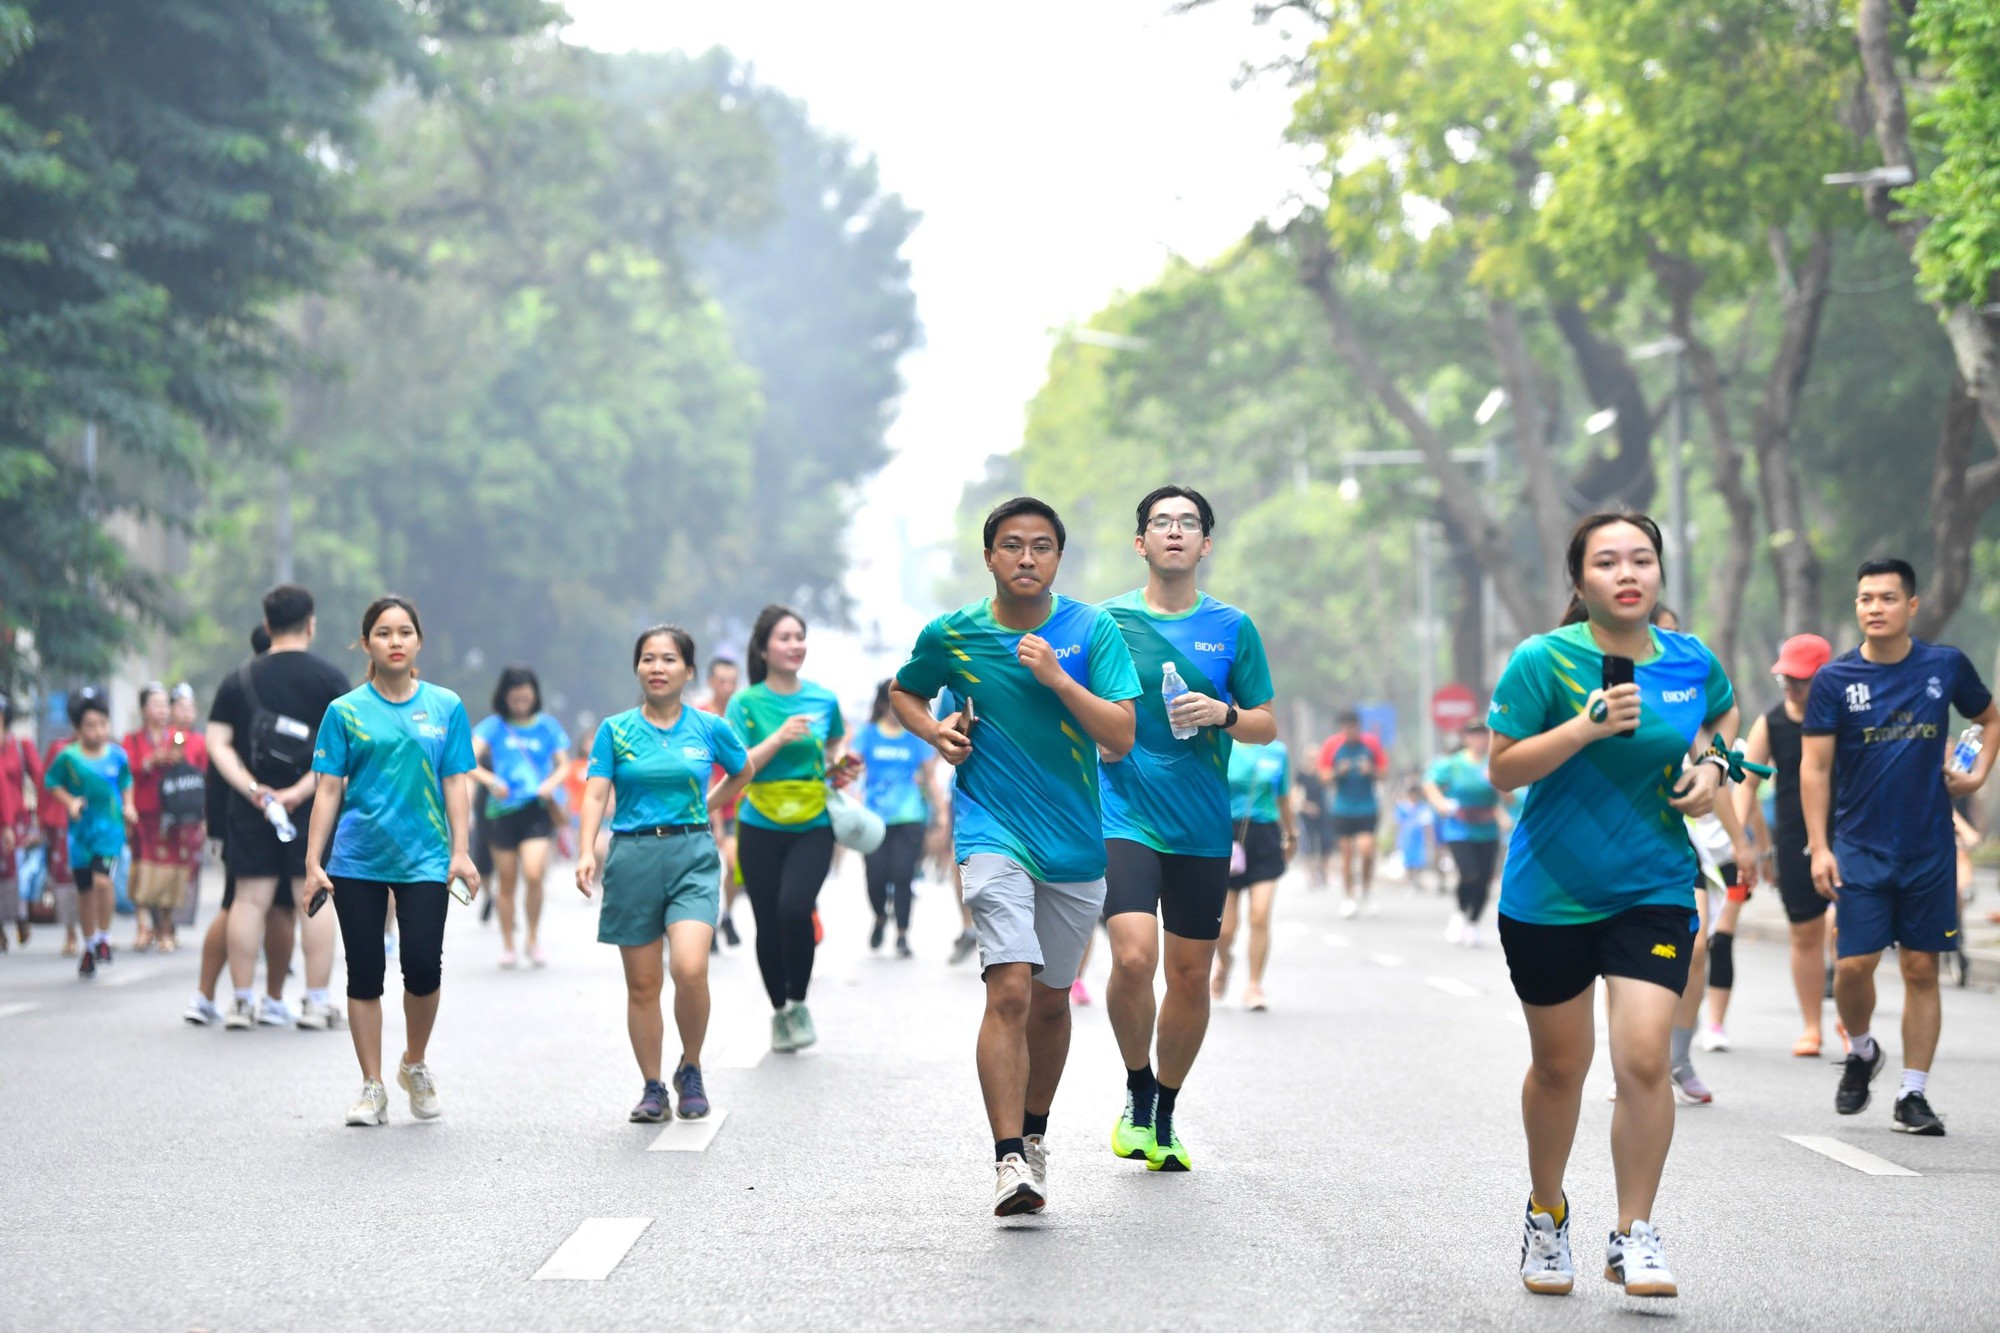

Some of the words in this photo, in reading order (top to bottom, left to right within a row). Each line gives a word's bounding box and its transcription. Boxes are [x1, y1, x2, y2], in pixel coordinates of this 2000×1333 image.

[1194, 641, 1217, 652] BIDV
[1055, 647, 1071, 659] DV
[1662, 689, 1691, 703] BIDV
